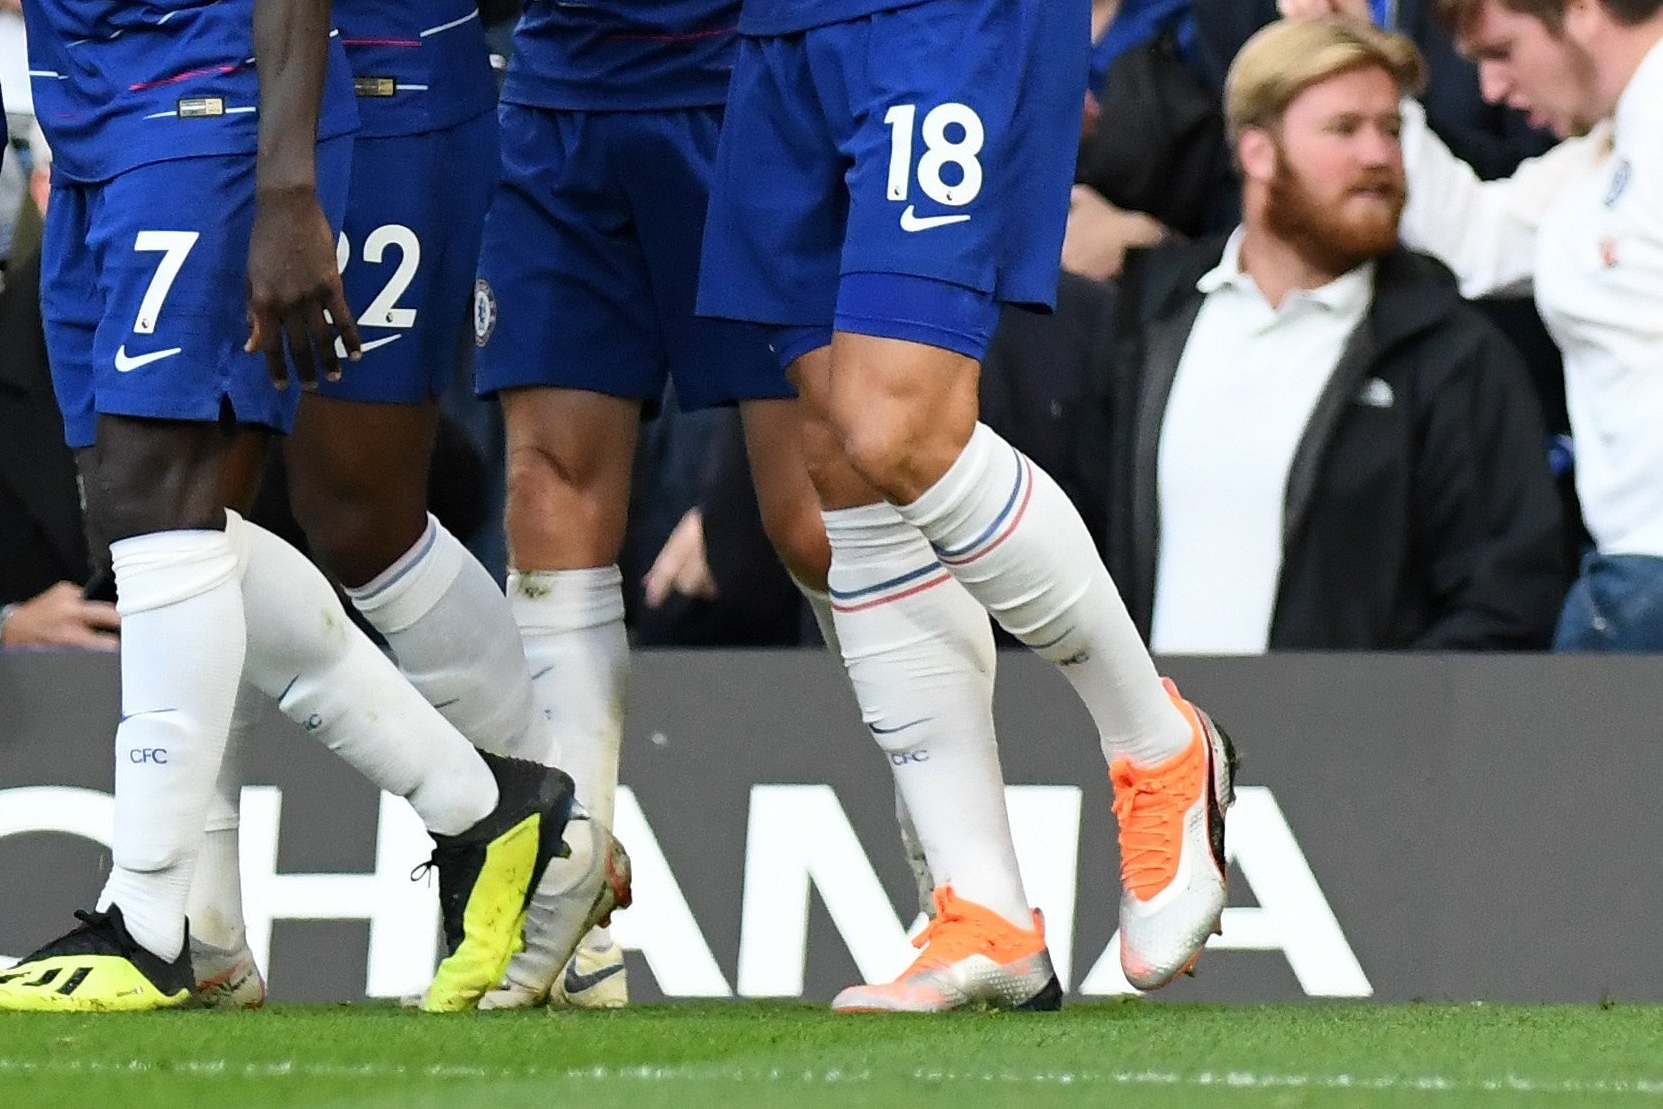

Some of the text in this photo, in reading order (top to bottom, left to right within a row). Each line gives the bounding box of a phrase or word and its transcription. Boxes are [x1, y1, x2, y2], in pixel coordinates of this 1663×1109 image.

[884, 102, 984, 206] 18
[133, 231, 199, 334] 7
[323, 224, 420, 328] 2
[129, 748, 168, 765] CFC
[891, 749, 930, 767] CFC
